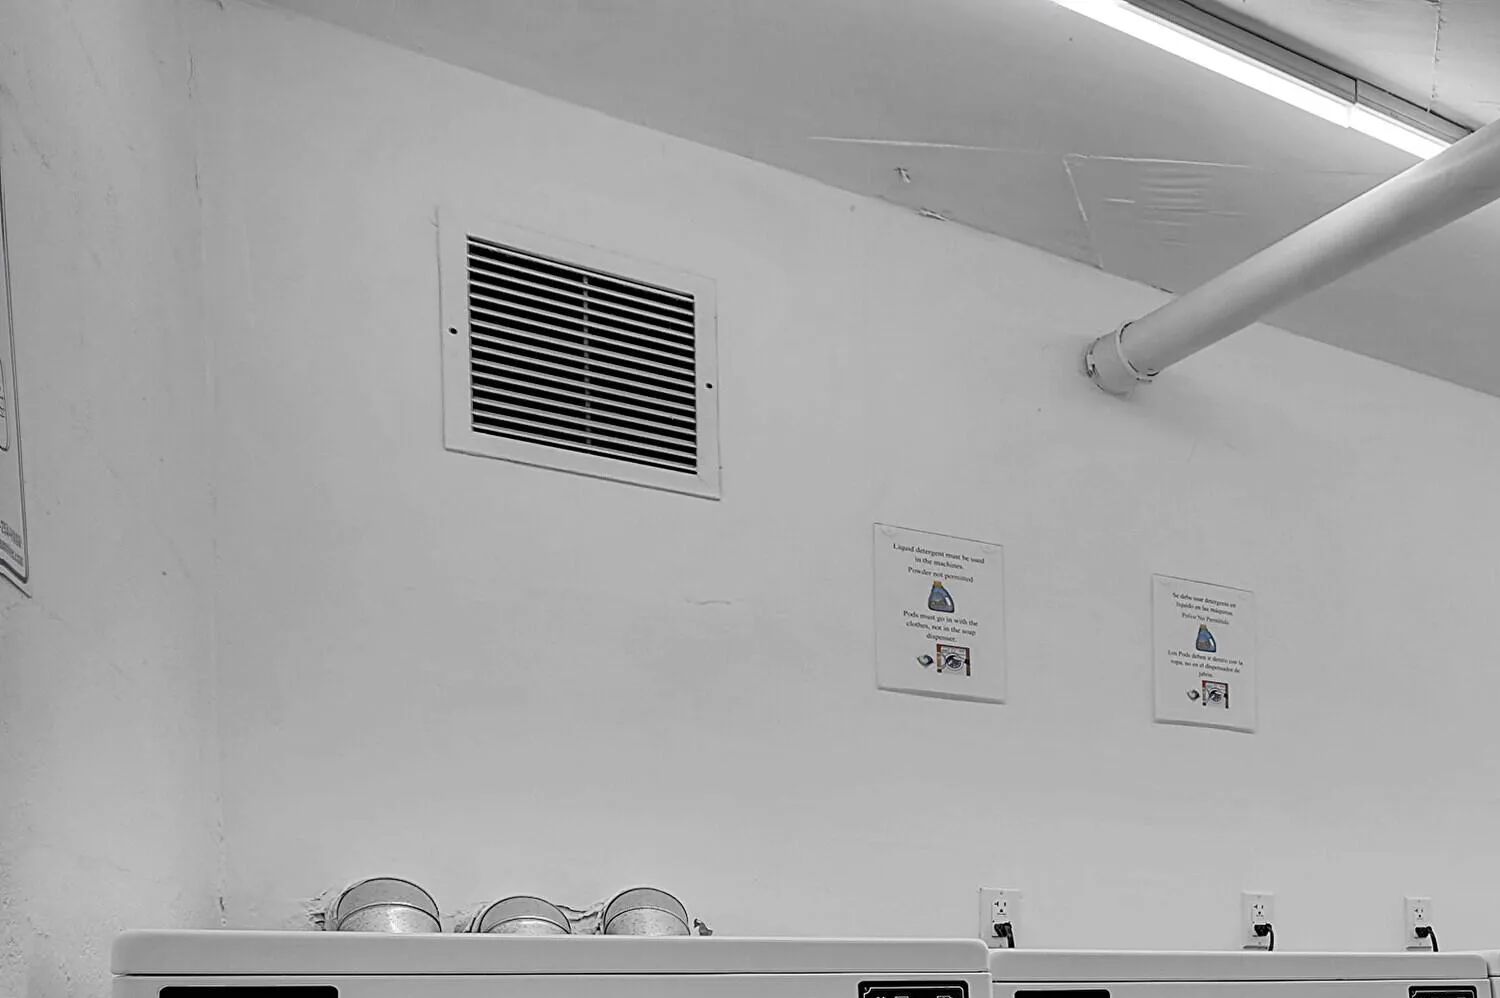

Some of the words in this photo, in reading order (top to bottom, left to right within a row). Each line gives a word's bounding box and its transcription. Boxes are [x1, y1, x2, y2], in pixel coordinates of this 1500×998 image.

[893, 544, 915, 553] Liquid
[915, 547, 944, 557] detergent
[945, 552, 960, 560] must
[908, 566, 931, 576] Powder
[904, 610, 919, 618] Pods
